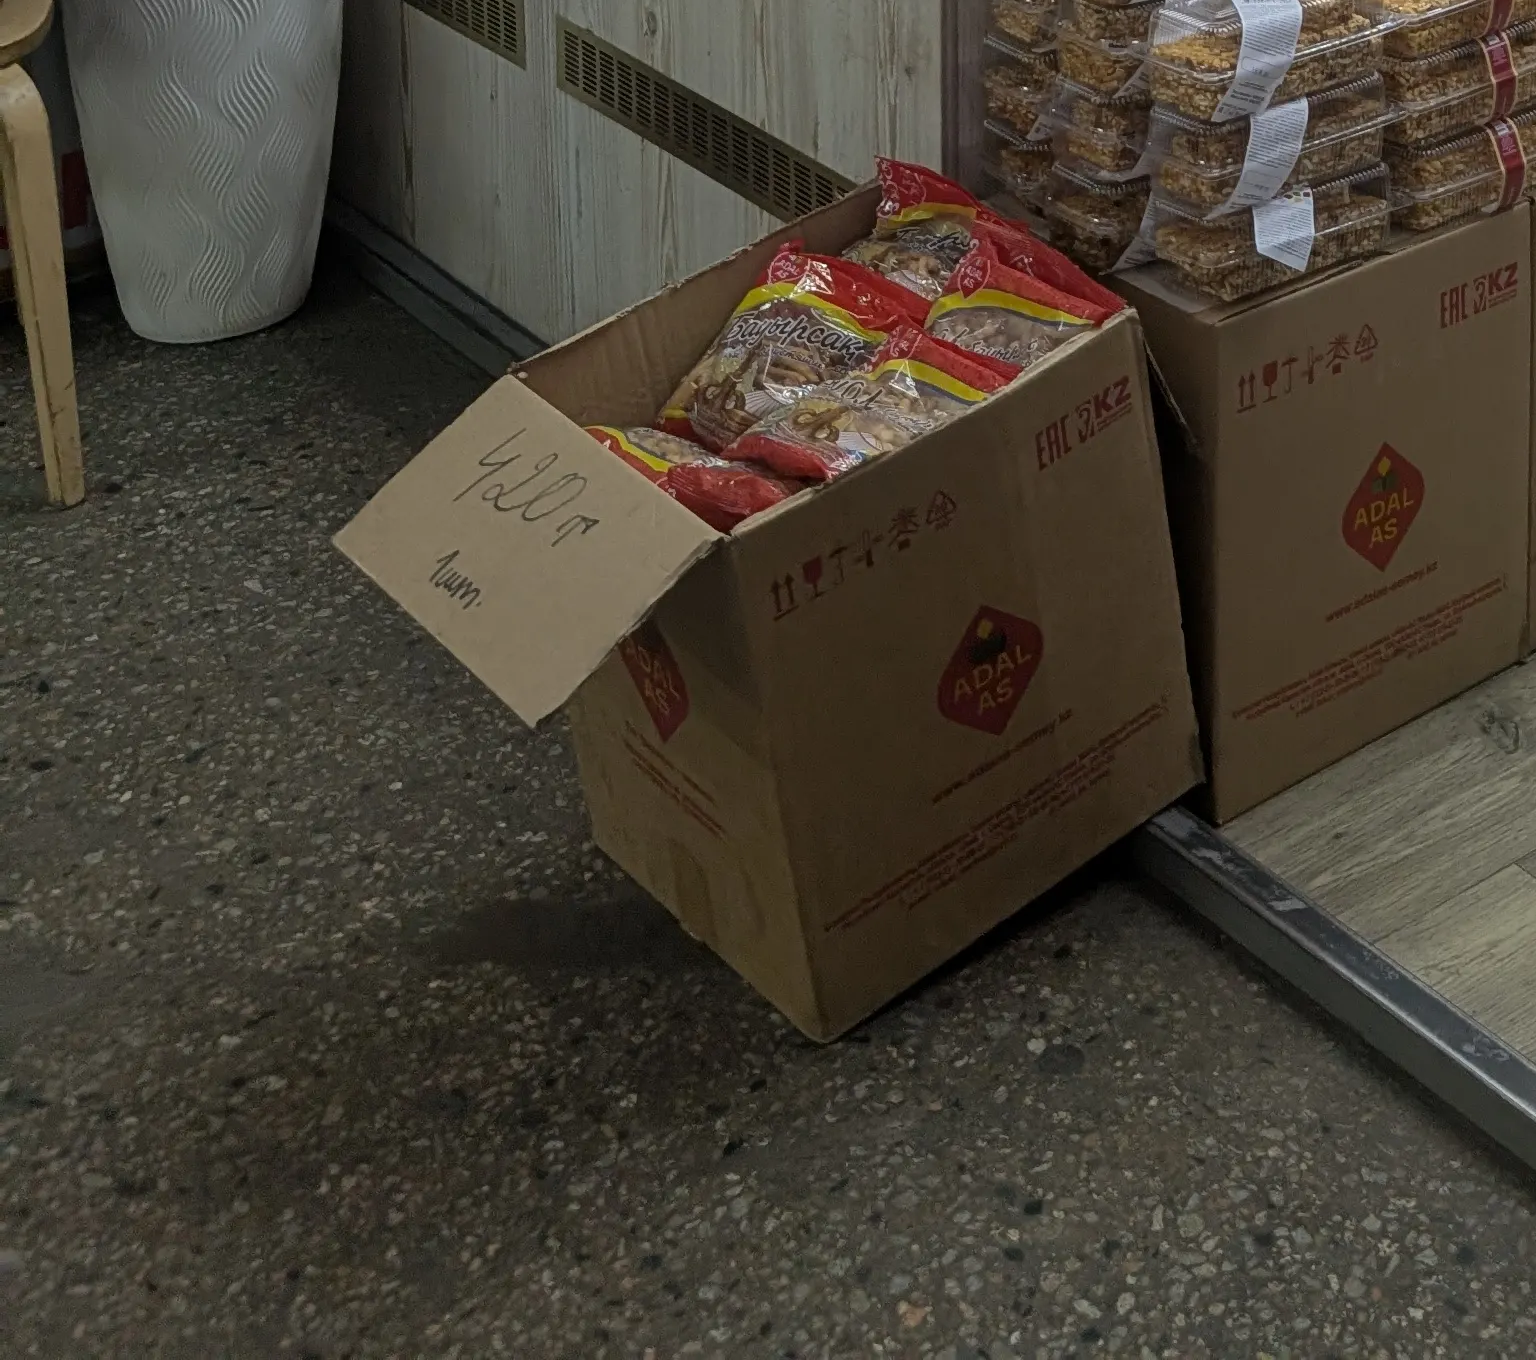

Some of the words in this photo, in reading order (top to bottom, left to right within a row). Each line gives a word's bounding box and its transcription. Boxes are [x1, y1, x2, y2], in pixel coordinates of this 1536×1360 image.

[1353, 487, 1415, 531] ADAL
[1367, 518, 1398, 549] AS
[953, 643, 1033, 704] ADAL
[977, 683, 1015, 717] AS
